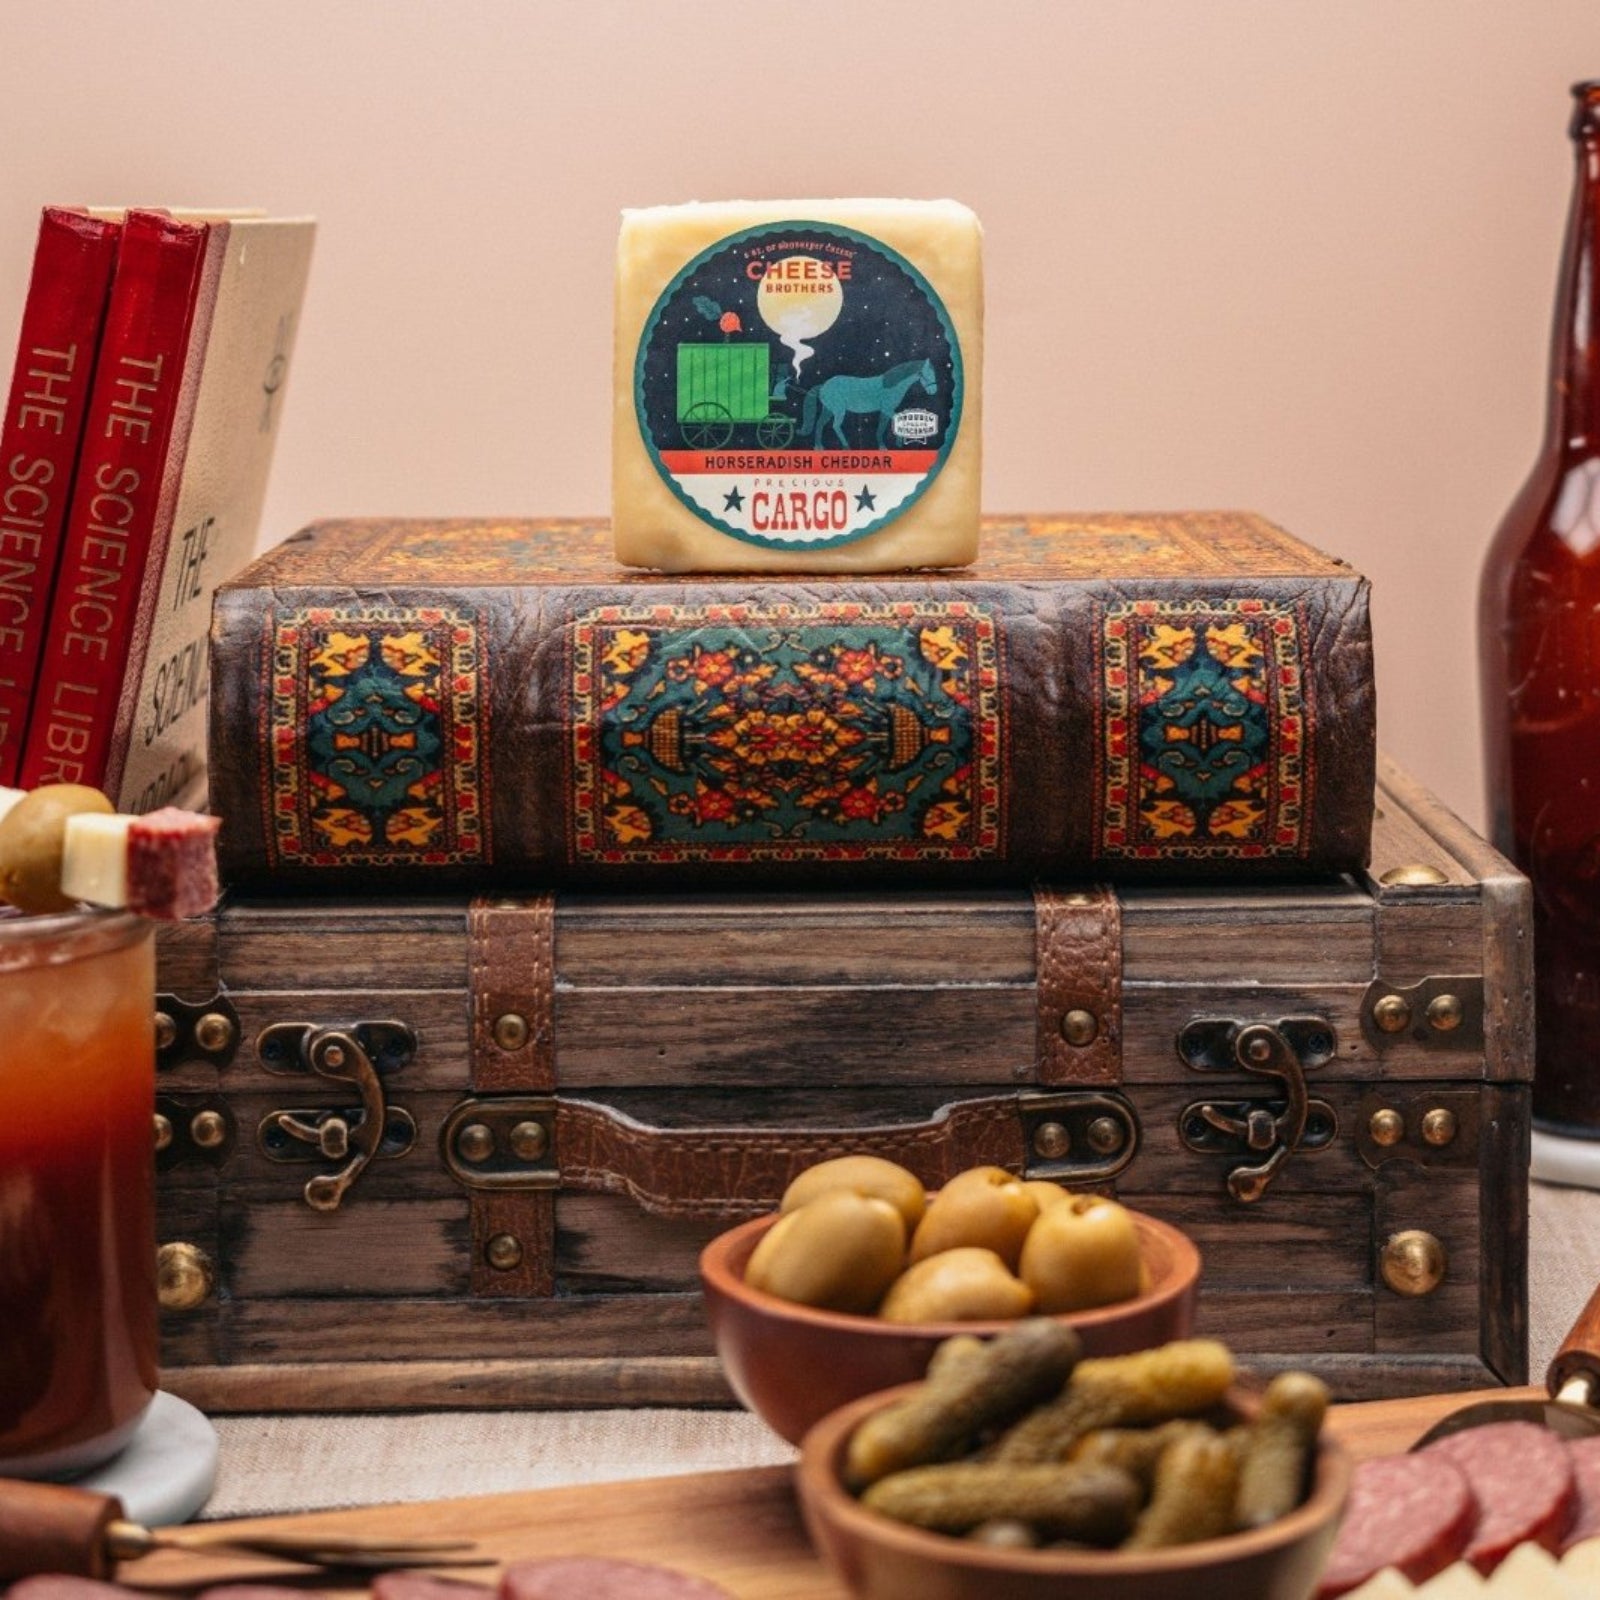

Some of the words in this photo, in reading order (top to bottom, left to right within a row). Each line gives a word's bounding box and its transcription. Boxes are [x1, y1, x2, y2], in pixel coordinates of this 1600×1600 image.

[745, 260, 853, 281] CHEESE
[765, 282, 834, 294] BROTHERS
[18, 343, 77, 436] THE
[104, 354, 164, 444] THE
[705, 456, 813, 469] HORSERADISH
[821, 455, 893, 469] CHEDDAR
[753, 478, 845, 488] PRECIOUS
[0, 453, 55, 653] SCIENCE
[752, 490, 848, 531] CARGO
[62, 463, 141, 662] SCIENCE
[173, 517, 215, 612] THE
[38, 680, 99, 784] LIBR
[144, 634, 209, 748] SCIEN
